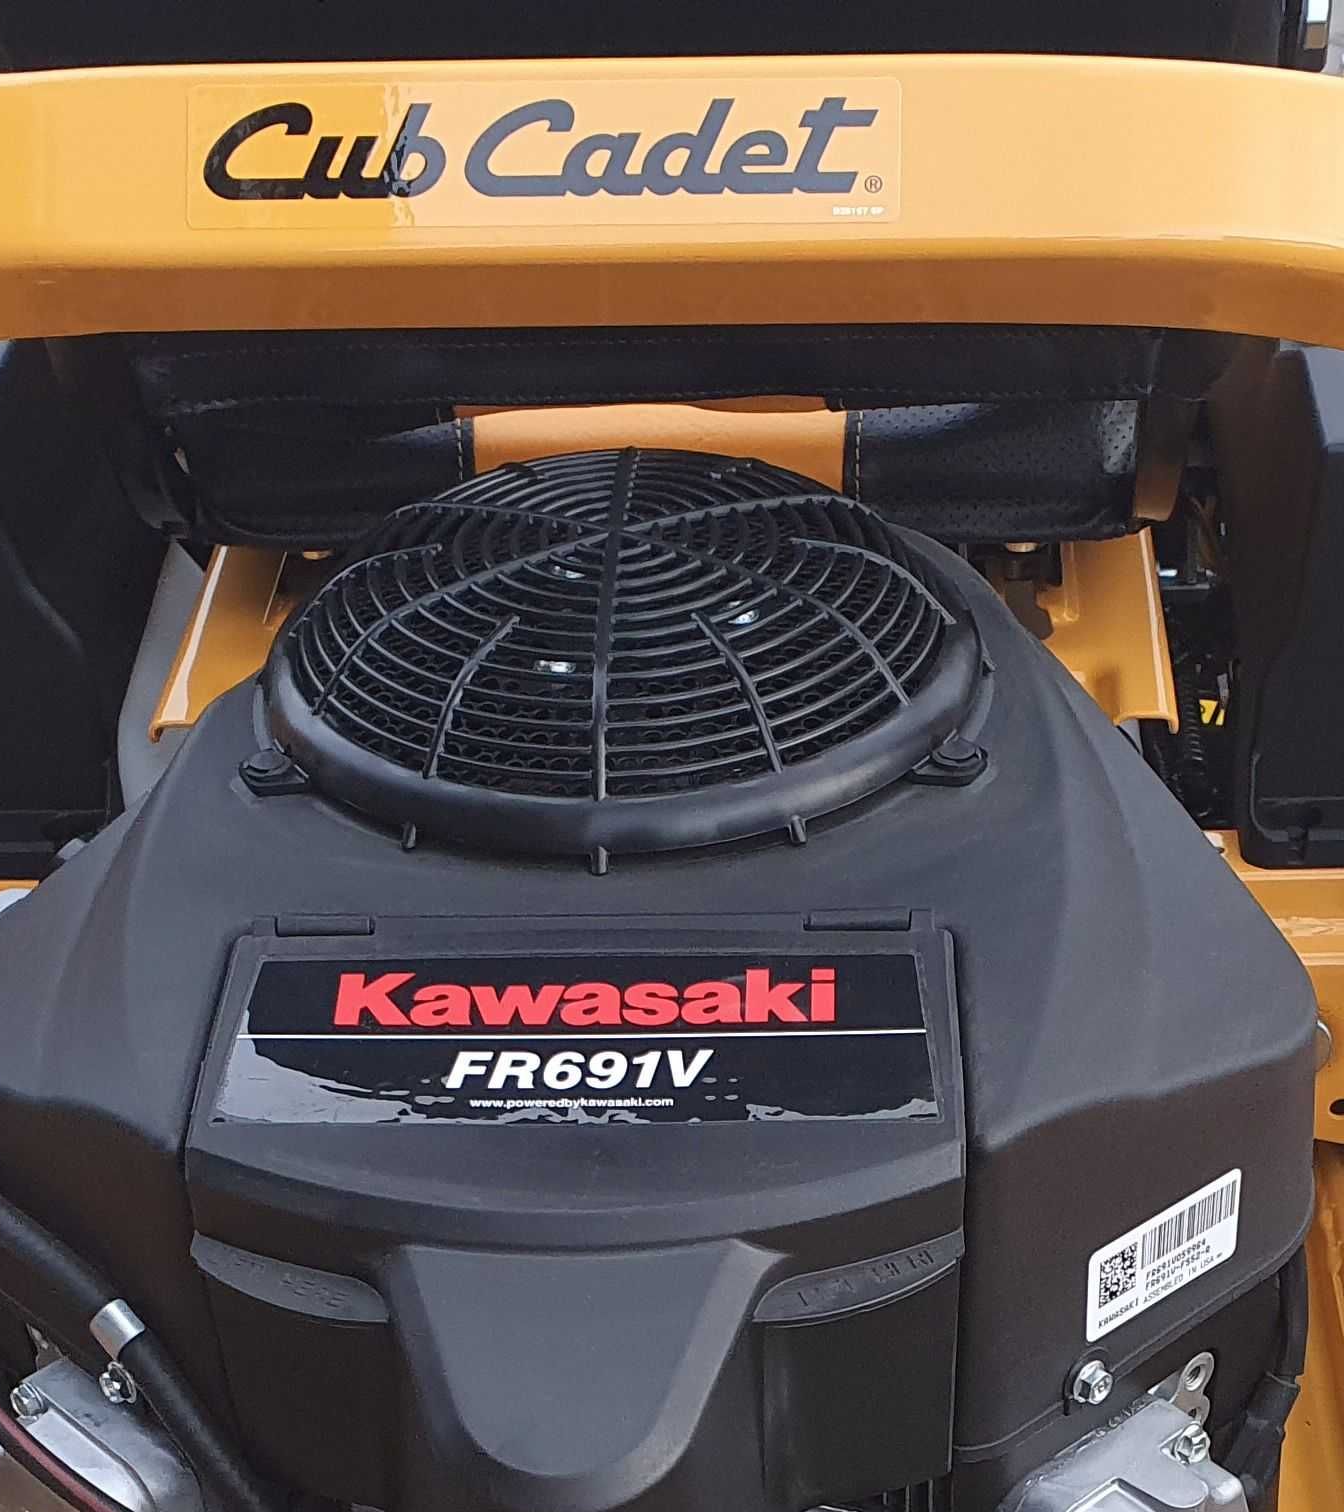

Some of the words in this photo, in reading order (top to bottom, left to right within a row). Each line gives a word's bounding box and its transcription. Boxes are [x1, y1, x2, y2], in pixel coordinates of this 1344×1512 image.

[203, 101, 447, 200] Cub
[464, 97, 879, 197] Cadet
[333, 967, 836, 1028] Kawasaki
[444, 1049, 715, 1090] FR691V
[469, 1096, 674, 1110] www.poweredbykawasaki.com
